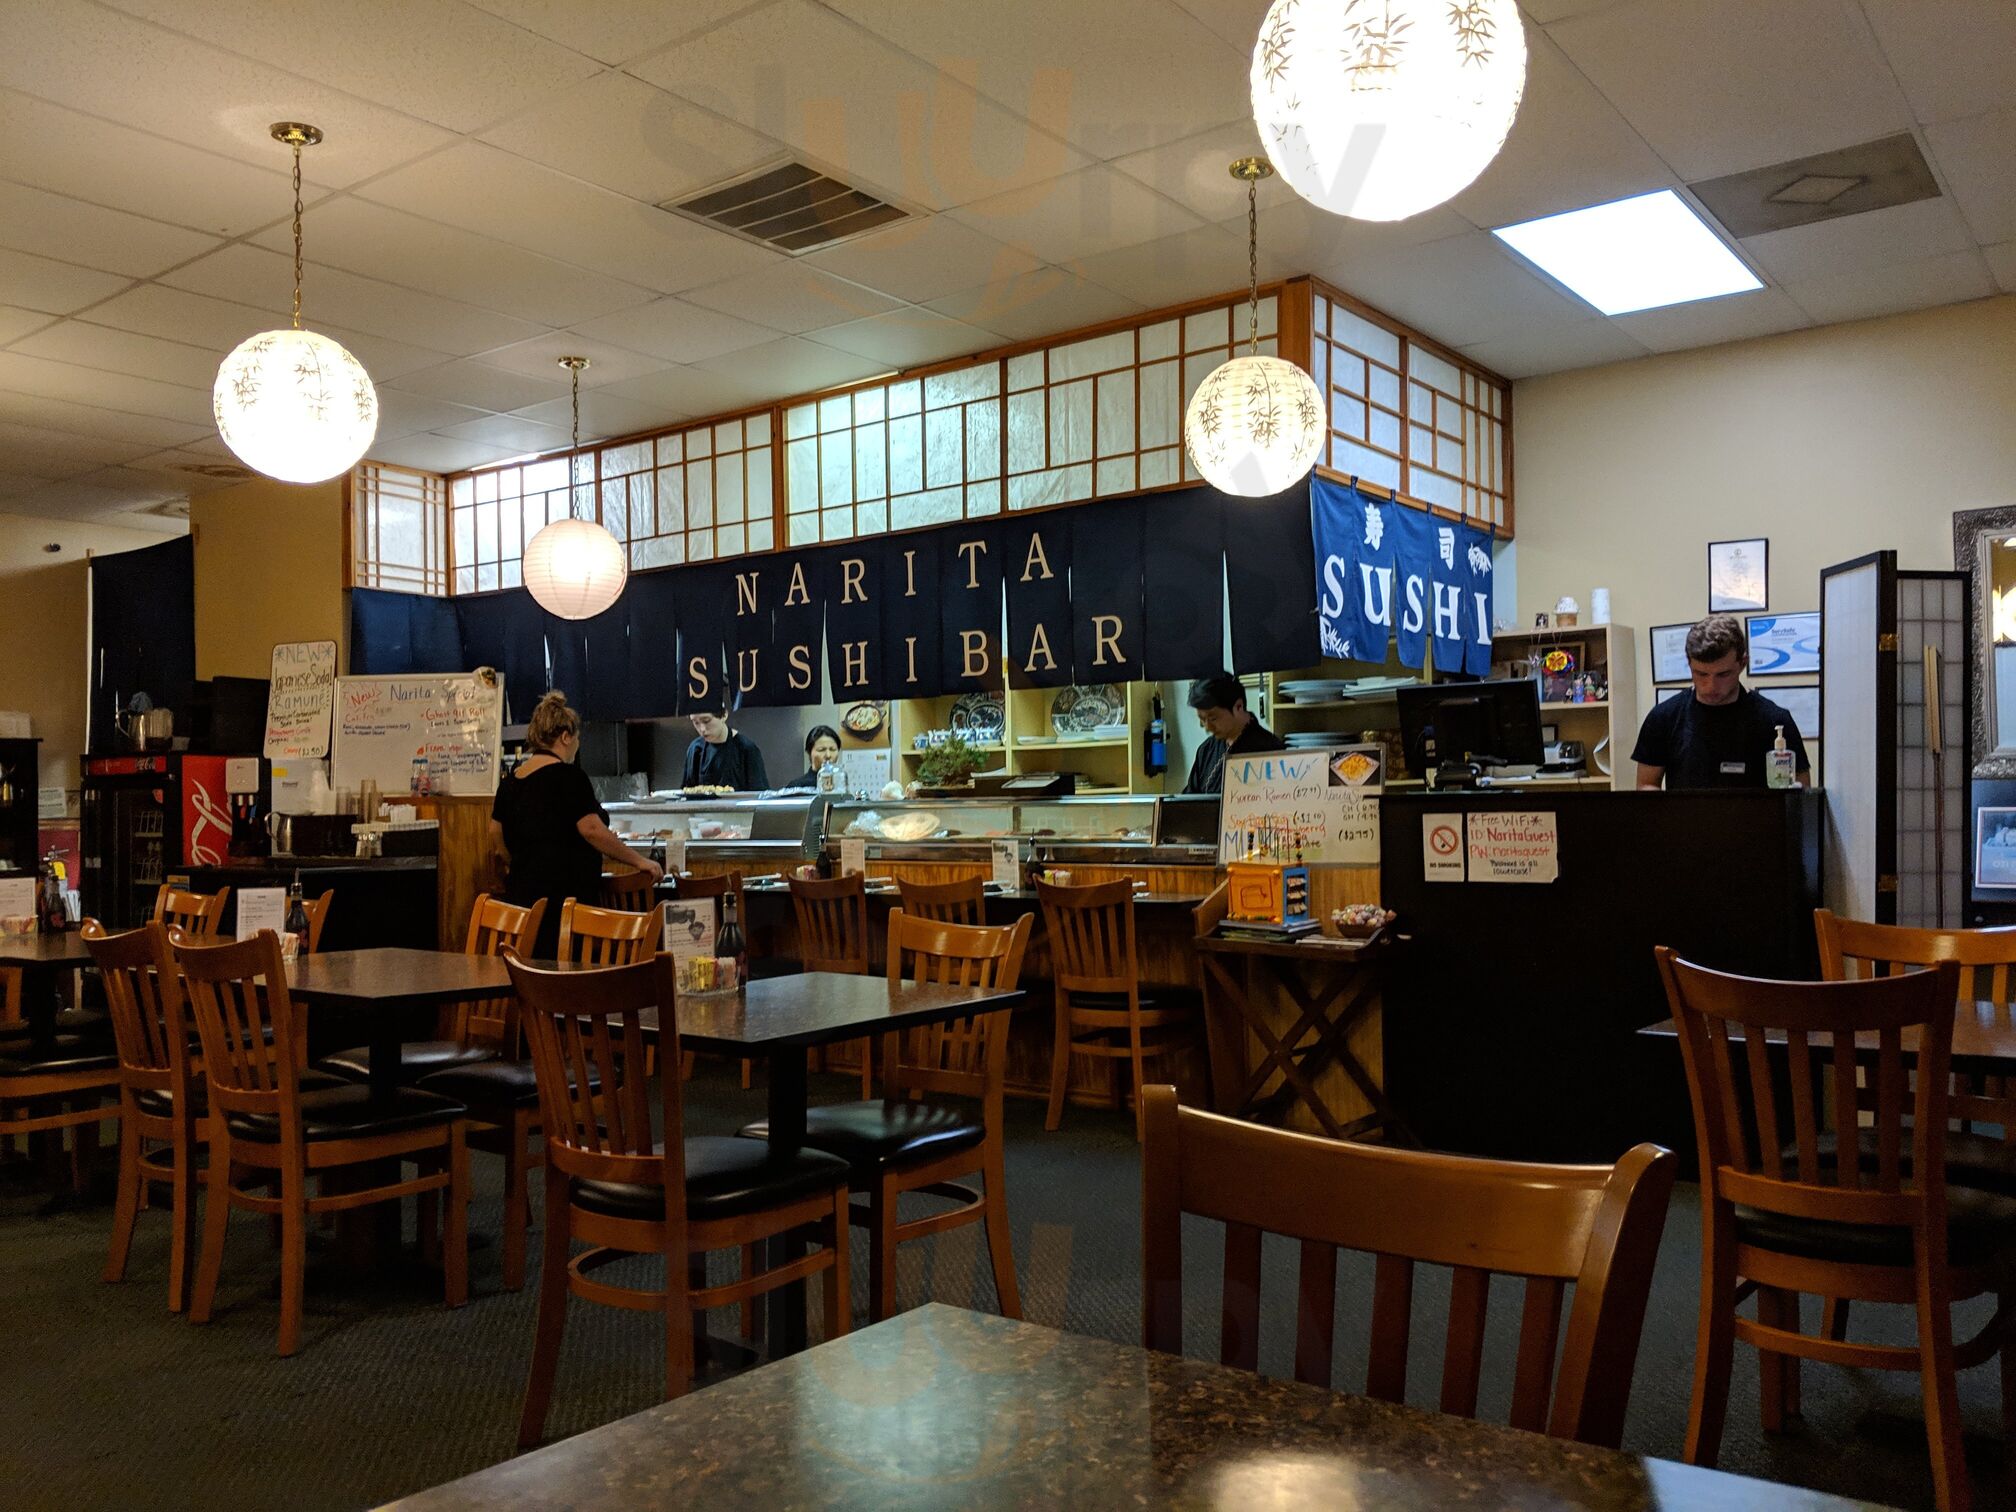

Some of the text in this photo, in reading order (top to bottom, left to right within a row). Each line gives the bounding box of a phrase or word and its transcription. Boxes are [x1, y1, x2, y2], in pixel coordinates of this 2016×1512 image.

[735, 532, 1055, 617] NARITA
[1322, 553, 1493, 646] SUSHI
[688, 614, 1127, 699] SUSHI BAR
[390, 683, 432, 702] Narita
[1242, 758, 1303, 784] NEW
[1487, 827, 1556, 843] NaritaGuest
